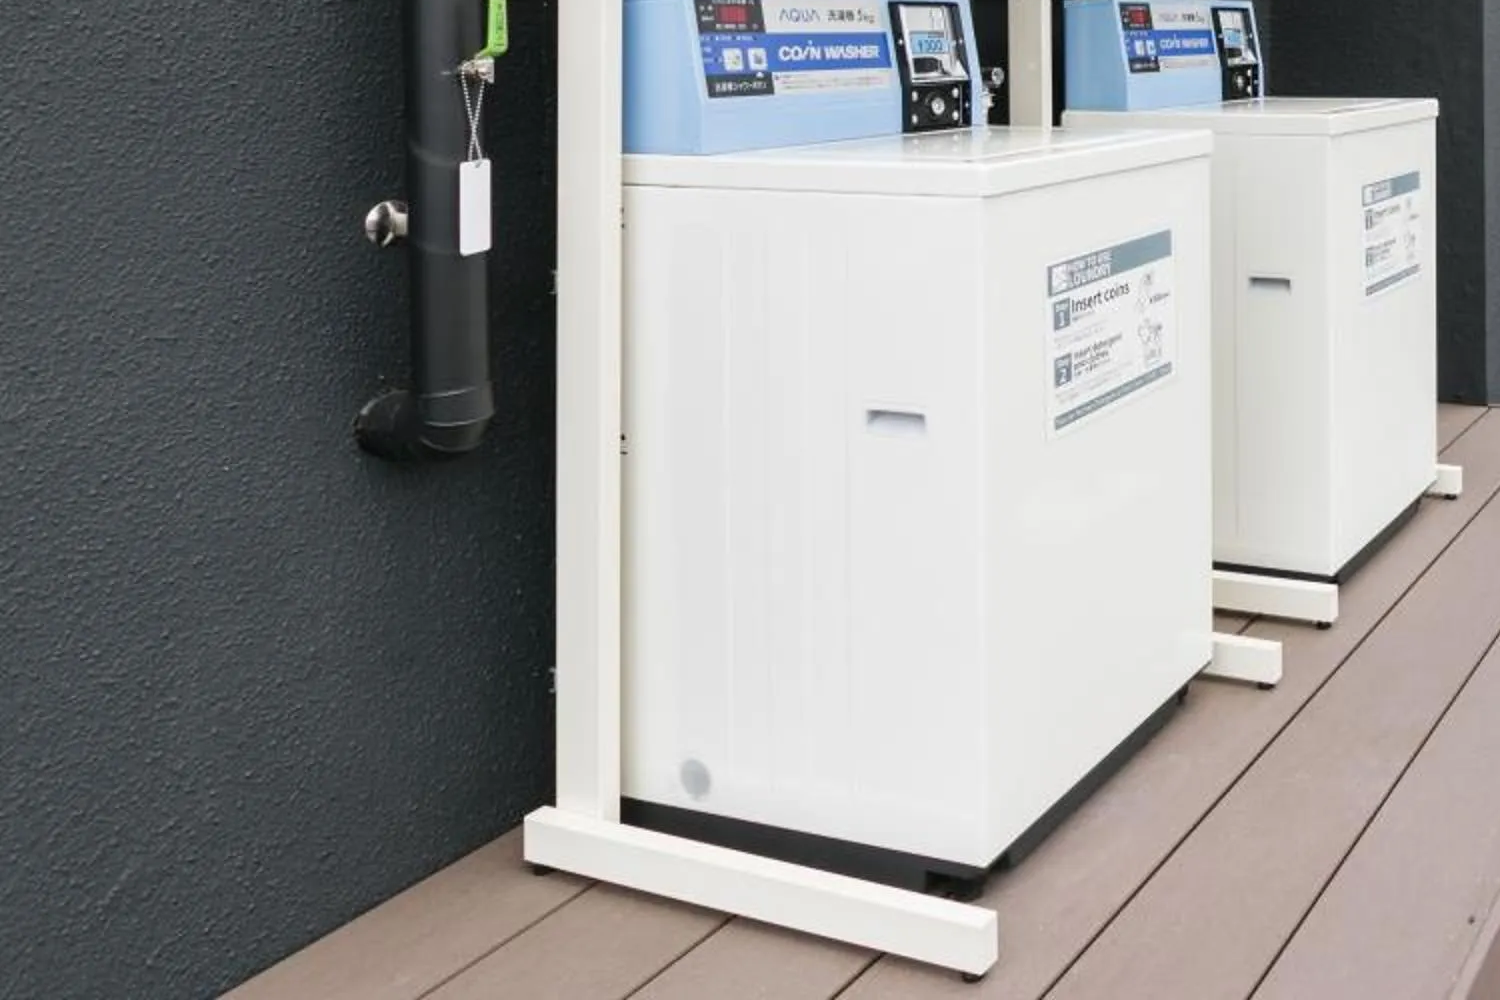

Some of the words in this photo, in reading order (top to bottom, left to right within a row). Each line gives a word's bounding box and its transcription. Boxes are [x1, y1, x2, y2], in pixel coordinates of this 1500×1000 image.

[779, 7, 820, 22] AQUA
[824, 45, 880, 59] WASHER
[1071, 291, 1102, 314] Insert
[1103, 283, 1131, 302] coins
